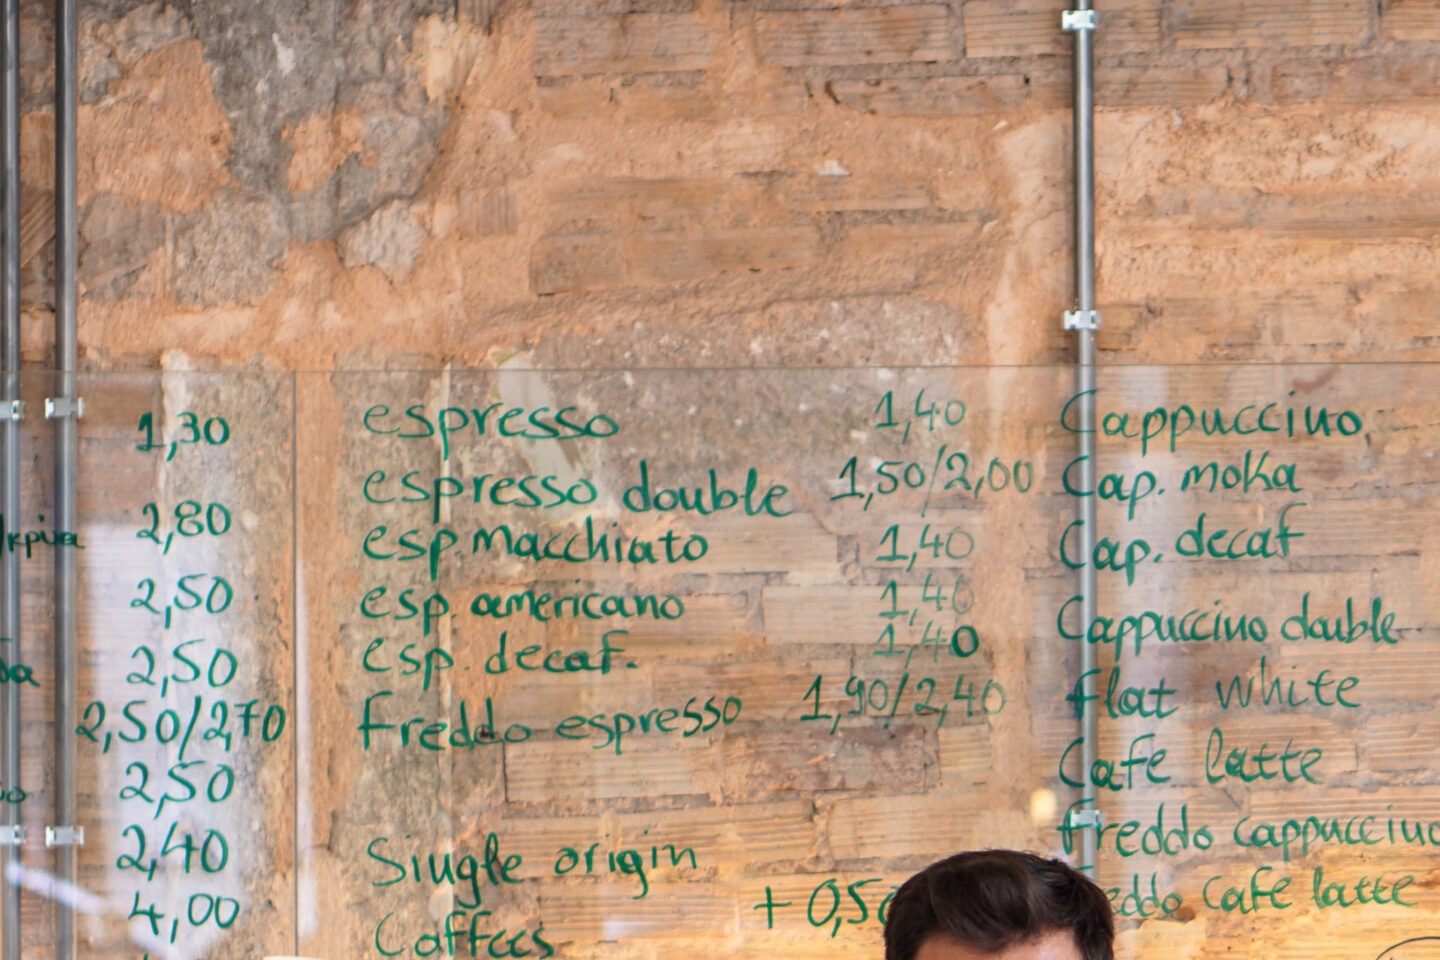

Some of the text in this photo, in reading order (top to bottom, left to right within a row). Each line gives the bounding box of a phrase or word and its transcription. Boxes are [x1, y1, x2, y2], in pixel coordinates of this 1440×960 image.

[135, 411, 231, 463] 1,30
[362, 388, 966, 463] espresso 1,40
[1060, 388, 1363, 461] Cappuccino
[362, 444, 1032, 525] espresso double 1,50/2,00
[1061, 451, 1165, 525] Cap.
[134, 499, 232, 556] 2,80
[875, 523, 978, 574] 1,40
[1059, 517, 1170, 591] Cap.
[1174, 502, 1308, 560] decaf
[128, 572, 235, 631] 2,50
[470, 578, 685, 623] americano
[877, 573, 974, 629] 1,40
[1056, 593, 1269, 665] Cappuccino
[1279, 592, 1399, 645] double
[125, 638, 239, 699] 2,50
[873, 617, 980, 669] 1,40
[1215, 655, 1361, 710] white
[555, 696, 742, 756] espresso
[1204, 727, 1323, 785] latte
[117, 759, 236, 822] 2,50
[114, 819, 230, 883] 2,40
[366, 829, 698, 913] Single origin
[127, 890, 241, 945] 4,00
[1312, 866, 1420, 909] latte
